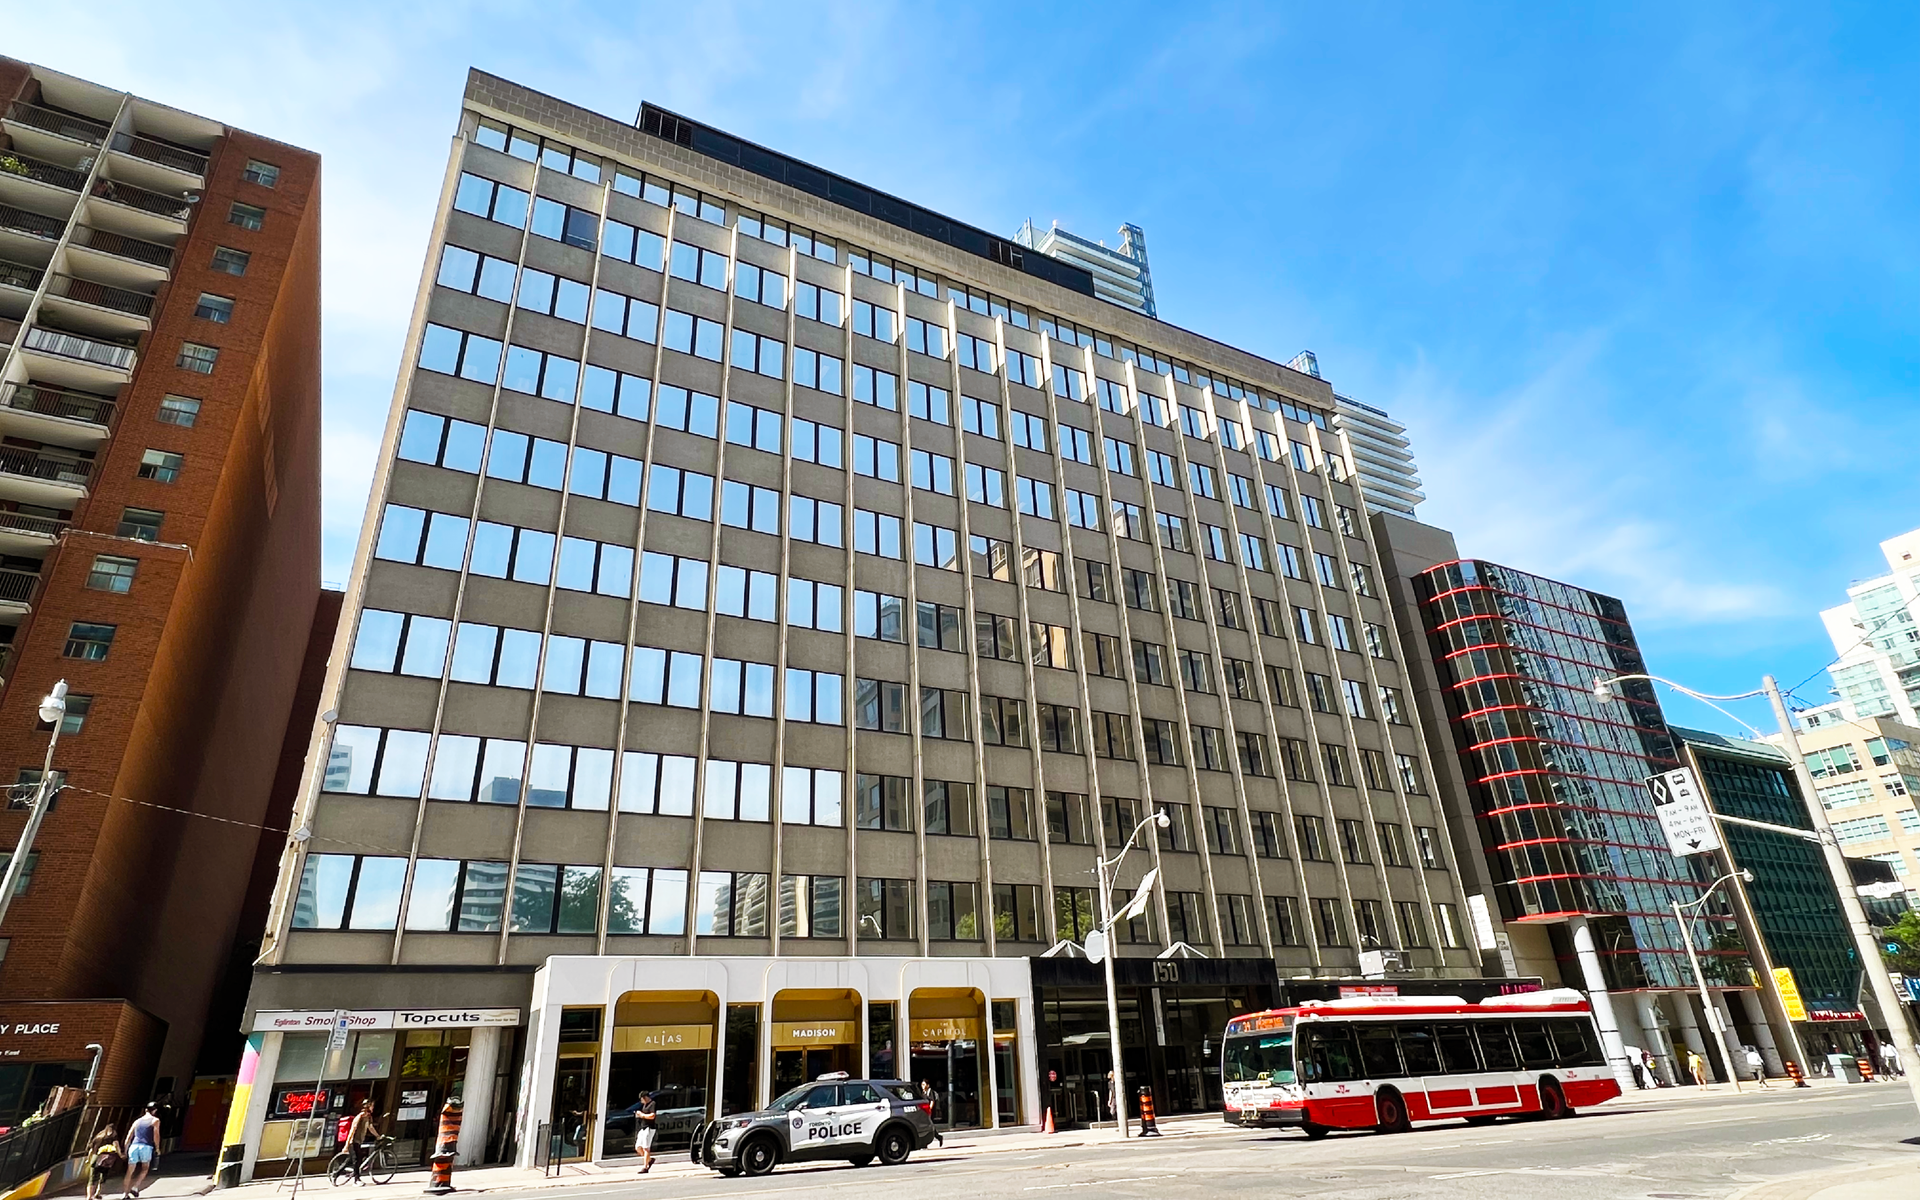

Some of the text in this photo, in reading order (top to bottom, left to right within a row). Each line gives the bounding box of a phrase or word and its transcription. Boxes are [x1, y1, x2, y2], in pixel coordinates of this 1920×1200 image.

[1673, 826, 1706, 839] MON-FRI
[1153, 961, 1179, 982] 150
[274, 1015, 377, 1027] Eglinton Smo Shop
[401, 1012, 481, 1025] Topcuts
[14, 1023, 60, 1035] PLACE
[792, 1028, 836, 1038] MADISON
[922, 1028, 966, 1037] CAPITOL
[808, 1119, 832, 1127] TORONTO
[808, 1122, 862, 1140] POLICE
